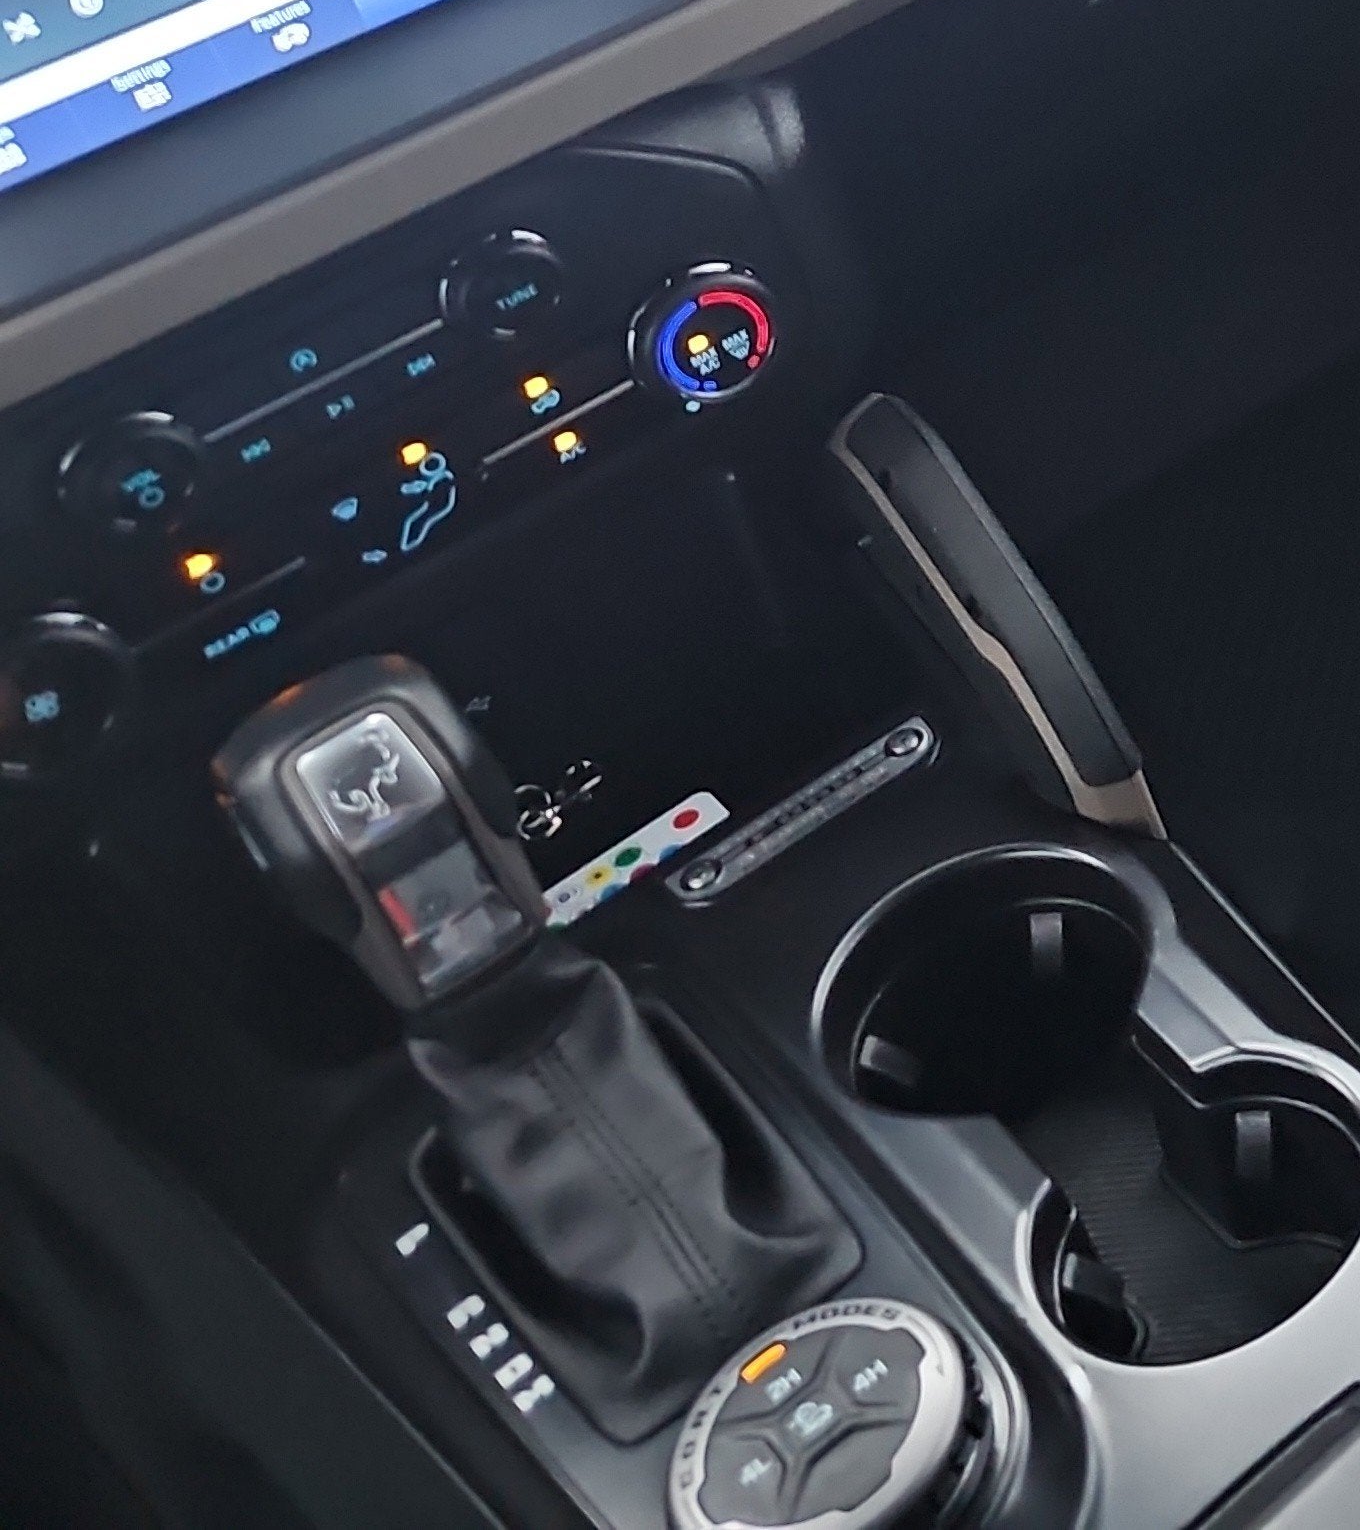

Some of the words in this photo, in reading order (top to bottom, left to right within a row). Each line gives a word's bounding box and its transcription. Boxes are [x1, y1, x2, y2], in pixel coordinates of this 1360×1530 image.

[689, 345, 719, 369] MAX
[852, 1357, 889, 1393] 4H
[739, 1457, 776, 1488] 4L
